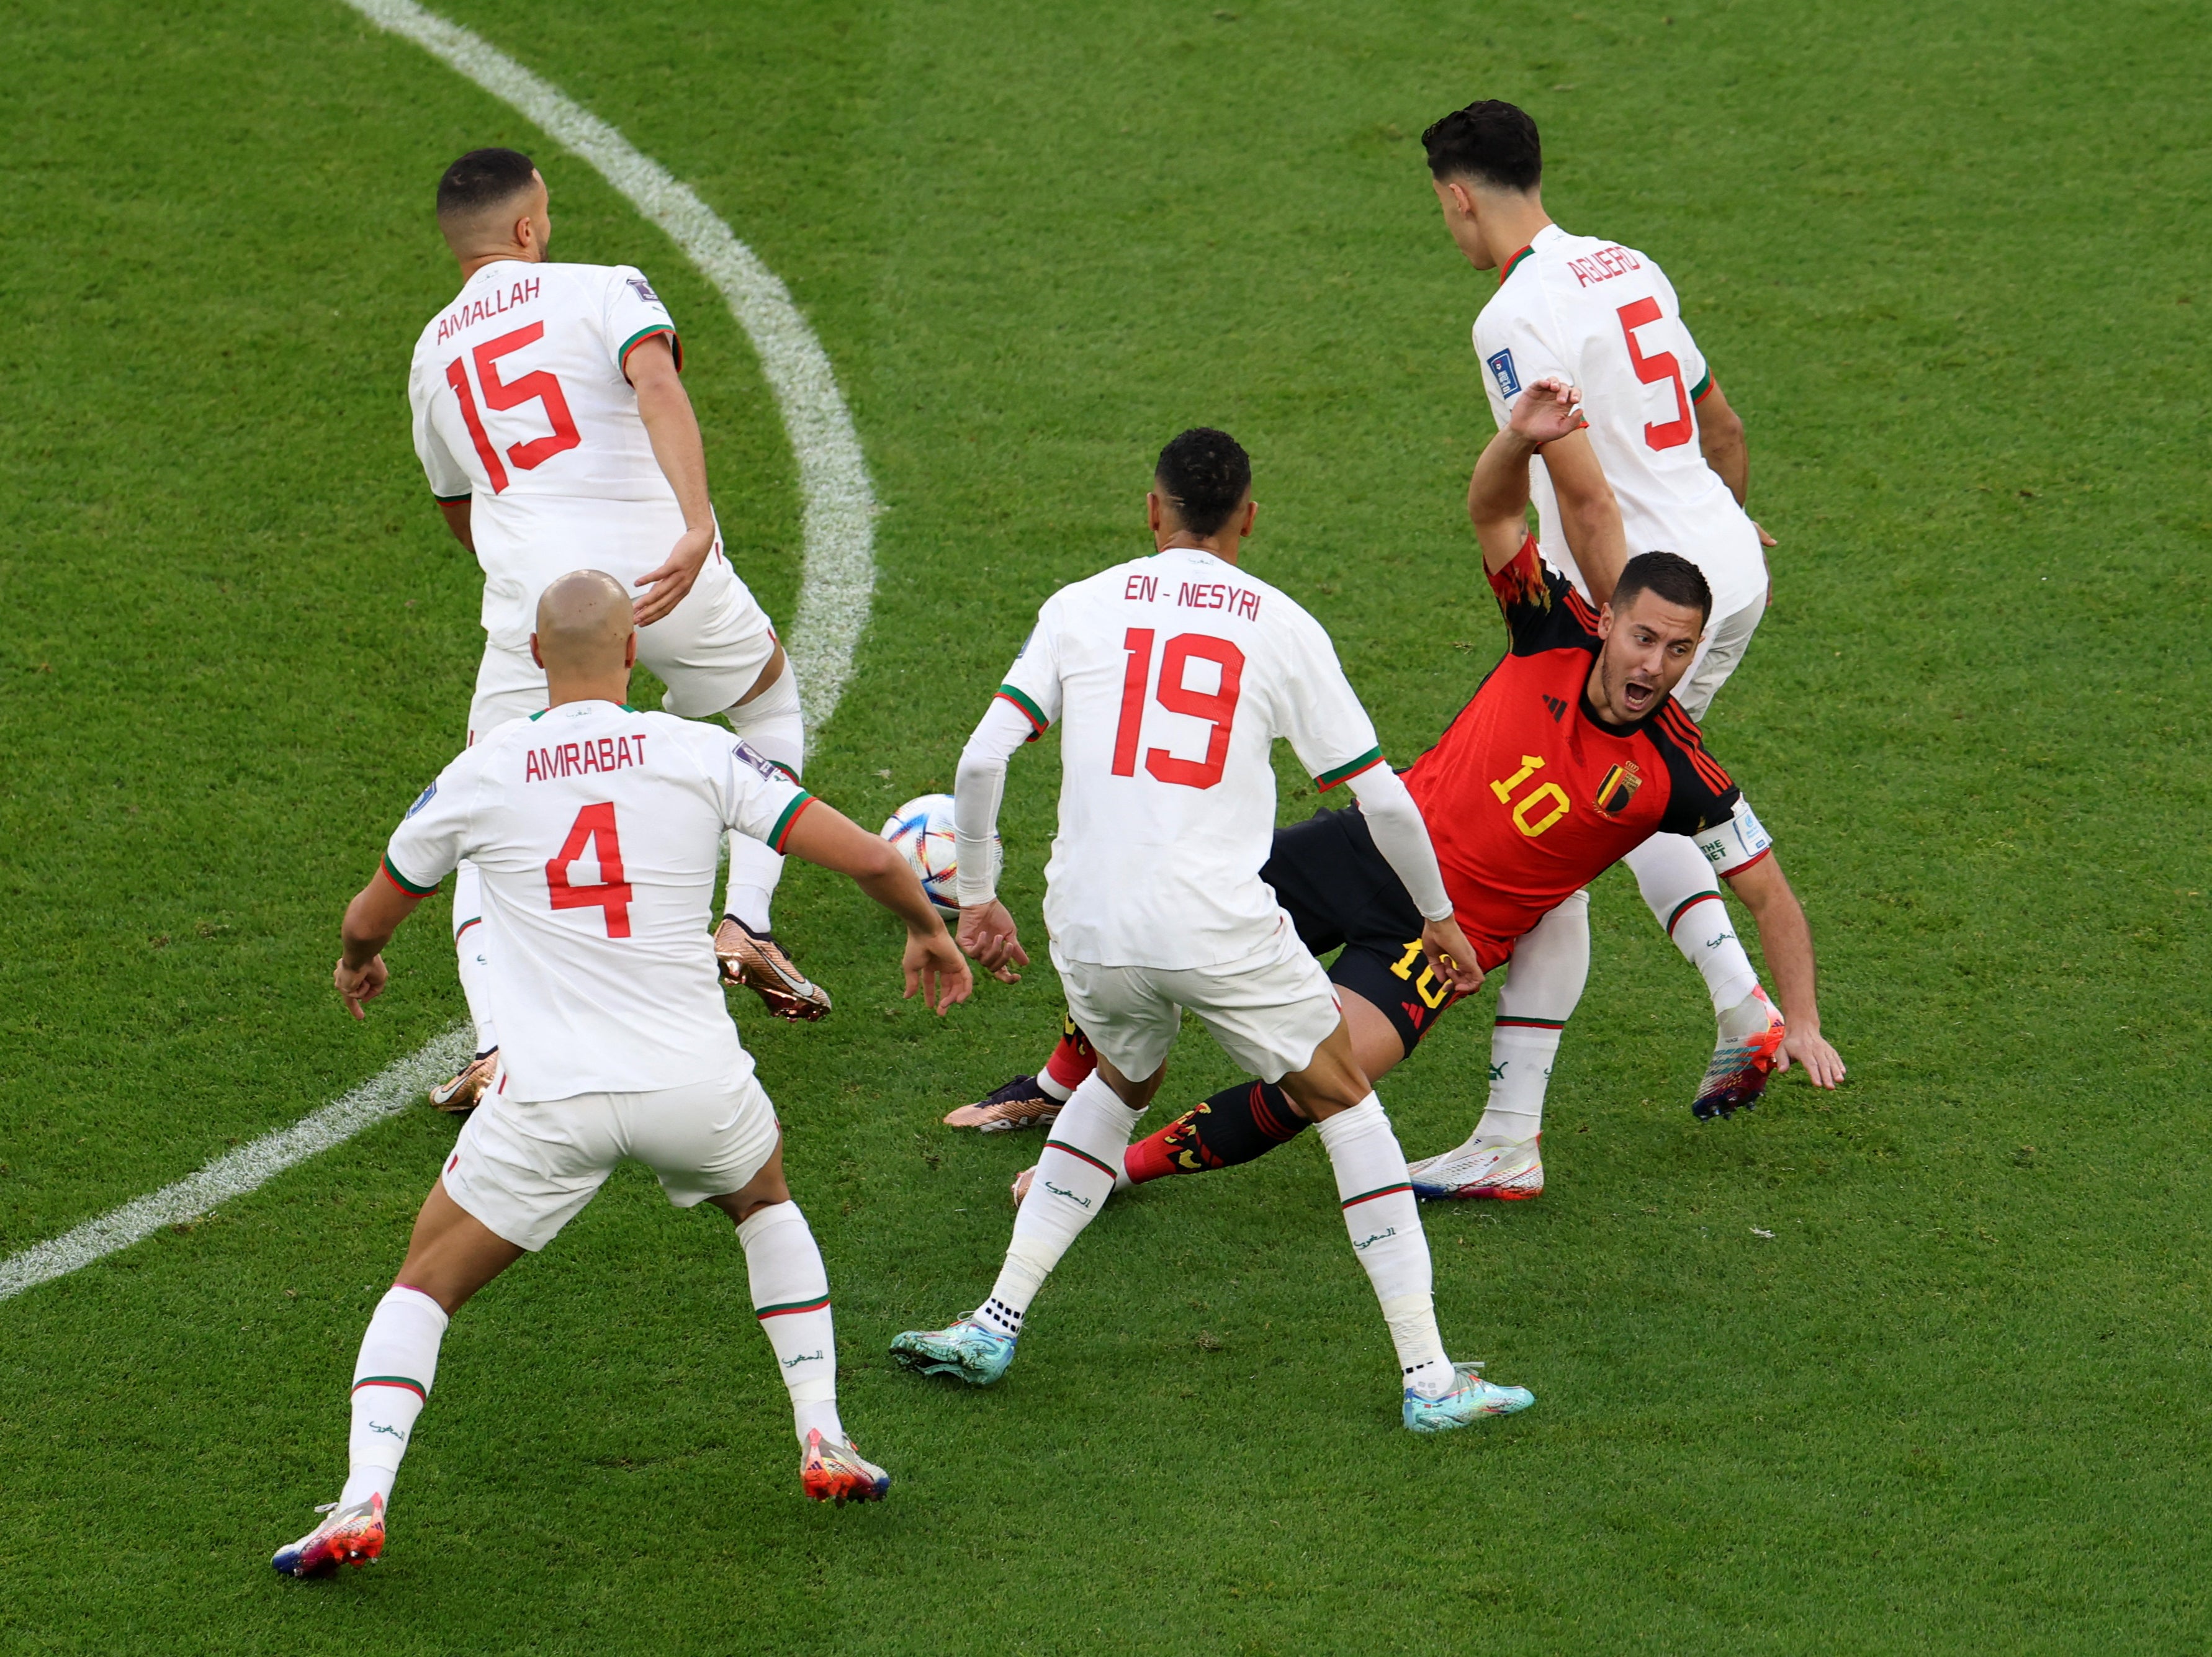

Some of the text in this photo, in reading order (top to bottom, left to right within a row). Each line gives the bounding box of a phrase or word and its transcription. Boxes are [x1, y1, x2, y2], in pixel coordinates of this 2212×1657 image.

[1567, 246, 1640, 287] AGUERD
[437, 277, 540, 345] AMALLAH
[1616, 295, 1693, 452] 5
[445, 320, 582, 496] 15
[1125, 575, 1159, 603] EN
[1178, 582, 1261, 622] NESYRI
[1111, 627, 1246, 790] 19
[526, 734, 647, 783] AMRABAT
[1490, 754, 1570, 838] 10
[545, 801, 634, 939] 4
[1700, 839, 1724, 854] THE
[1045, 1181, 1092, 1208] المغرب
[1353, 1226, 1396, 1251] المغرب
[781, 1349, 824, 1368] المغرب
